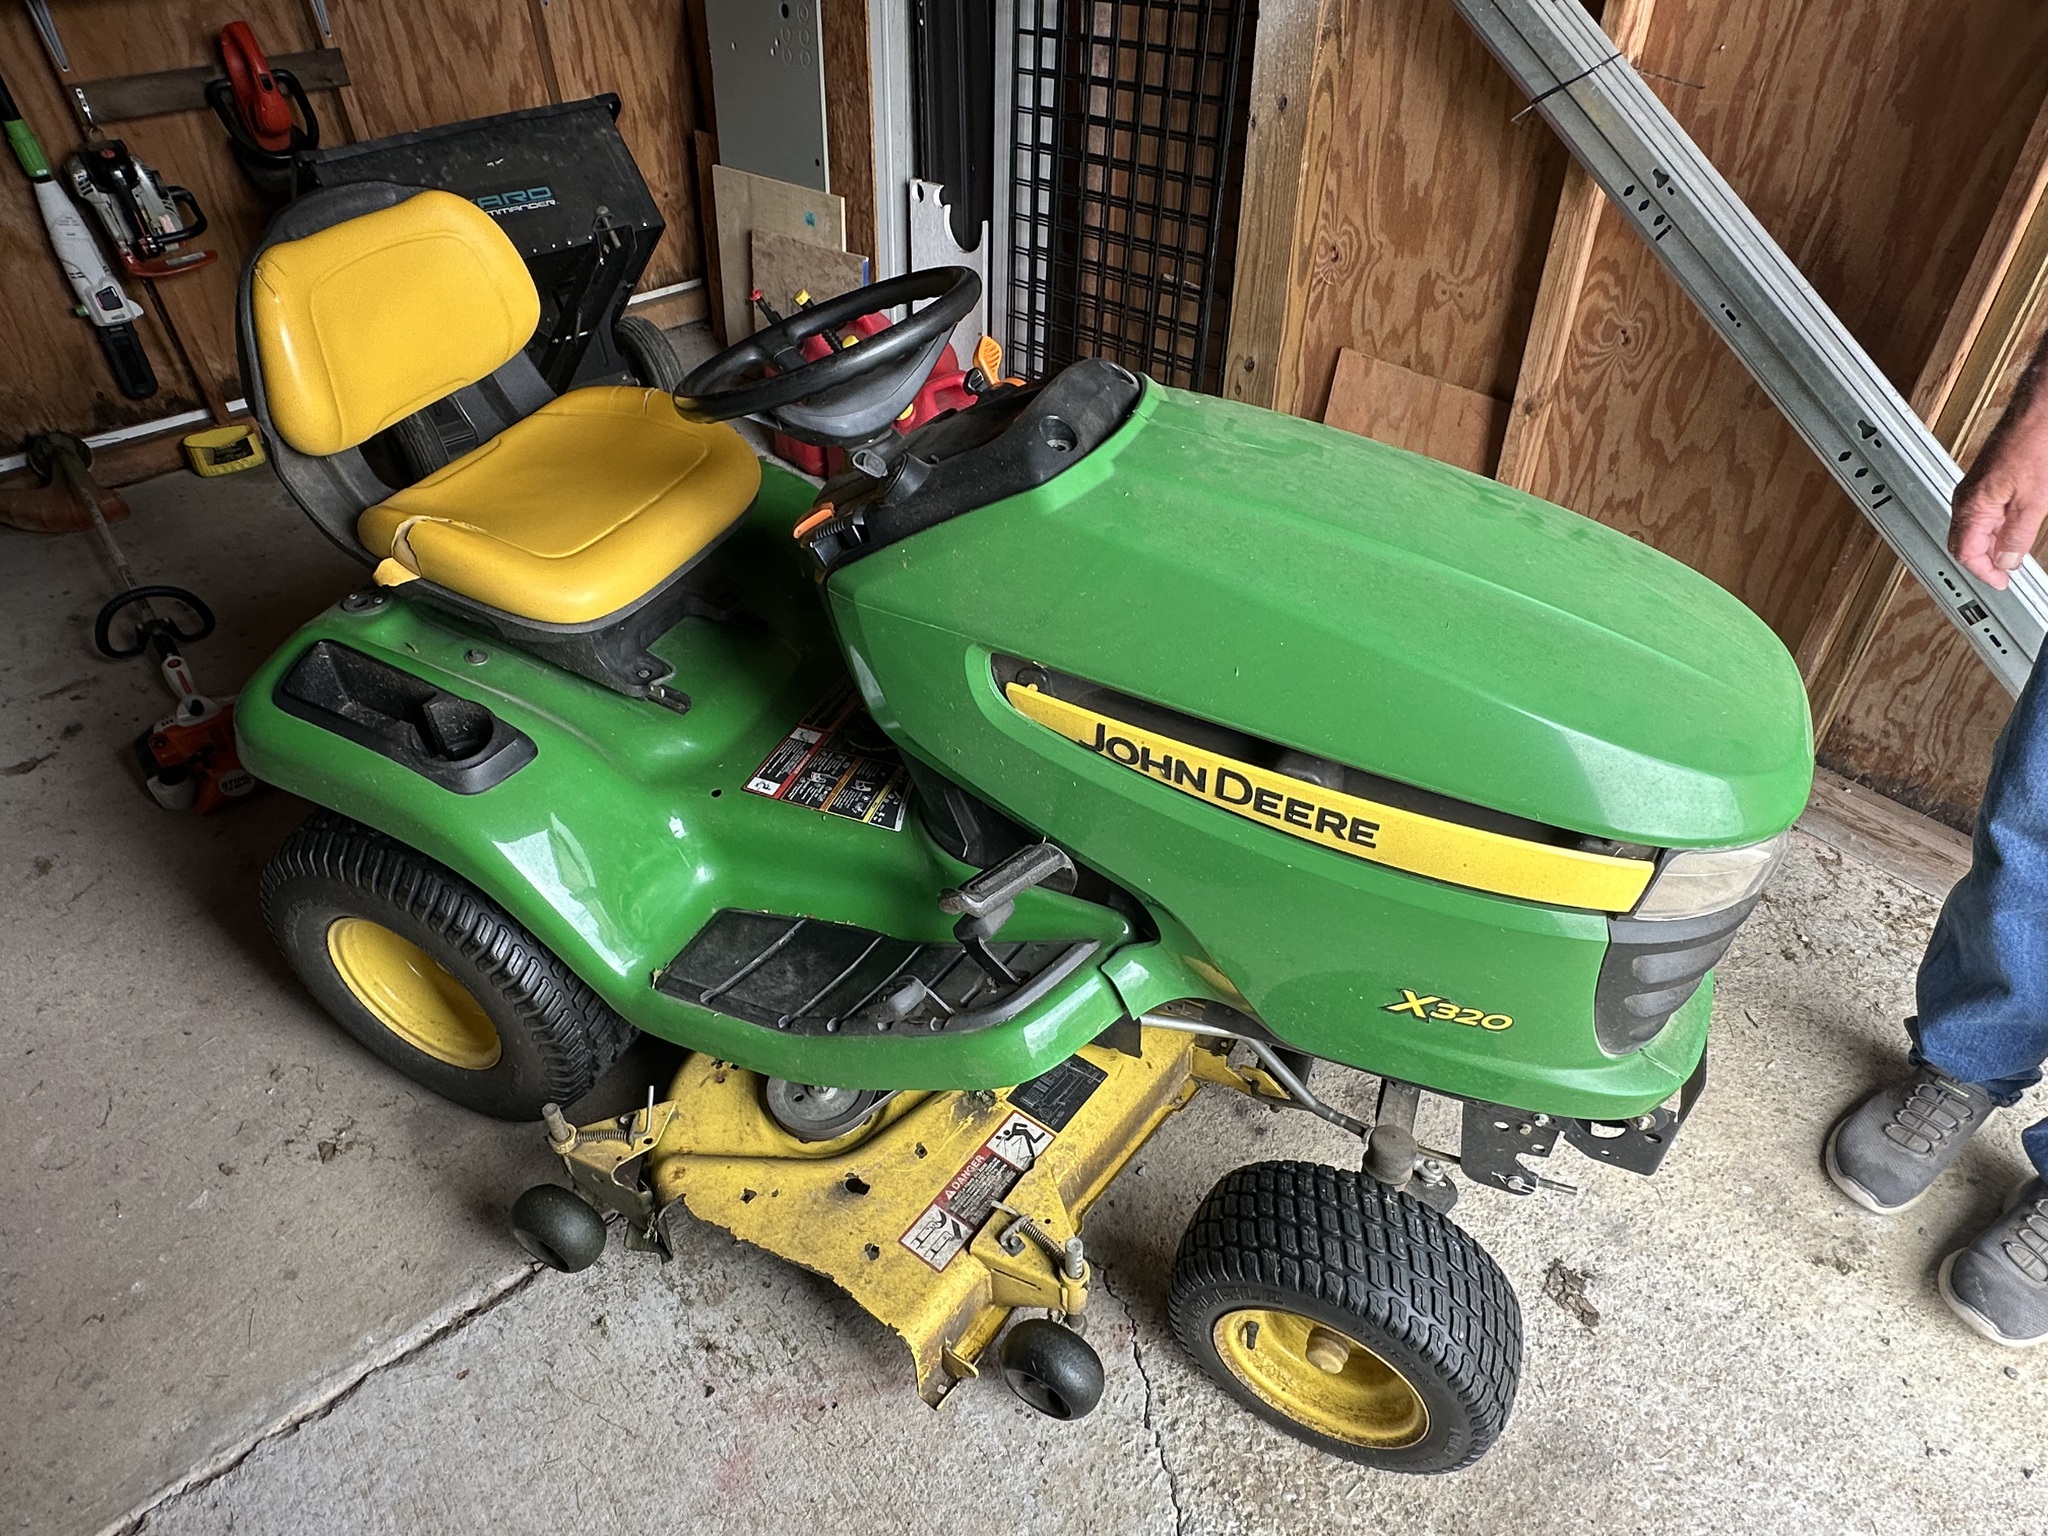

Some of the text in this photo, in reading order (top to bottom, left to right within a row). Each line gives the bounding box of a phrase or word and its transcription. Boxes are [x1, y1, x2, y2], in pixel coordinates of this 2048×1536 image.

[473, 186, 552, 208] ARD
[485, 199, 556, 216] MMANDER
[1079, 722, 1380, 848] JOHN DEERE
[1379, 988, 1515, 1031] X320
[951, 1154, 986, 1191] DANGER
